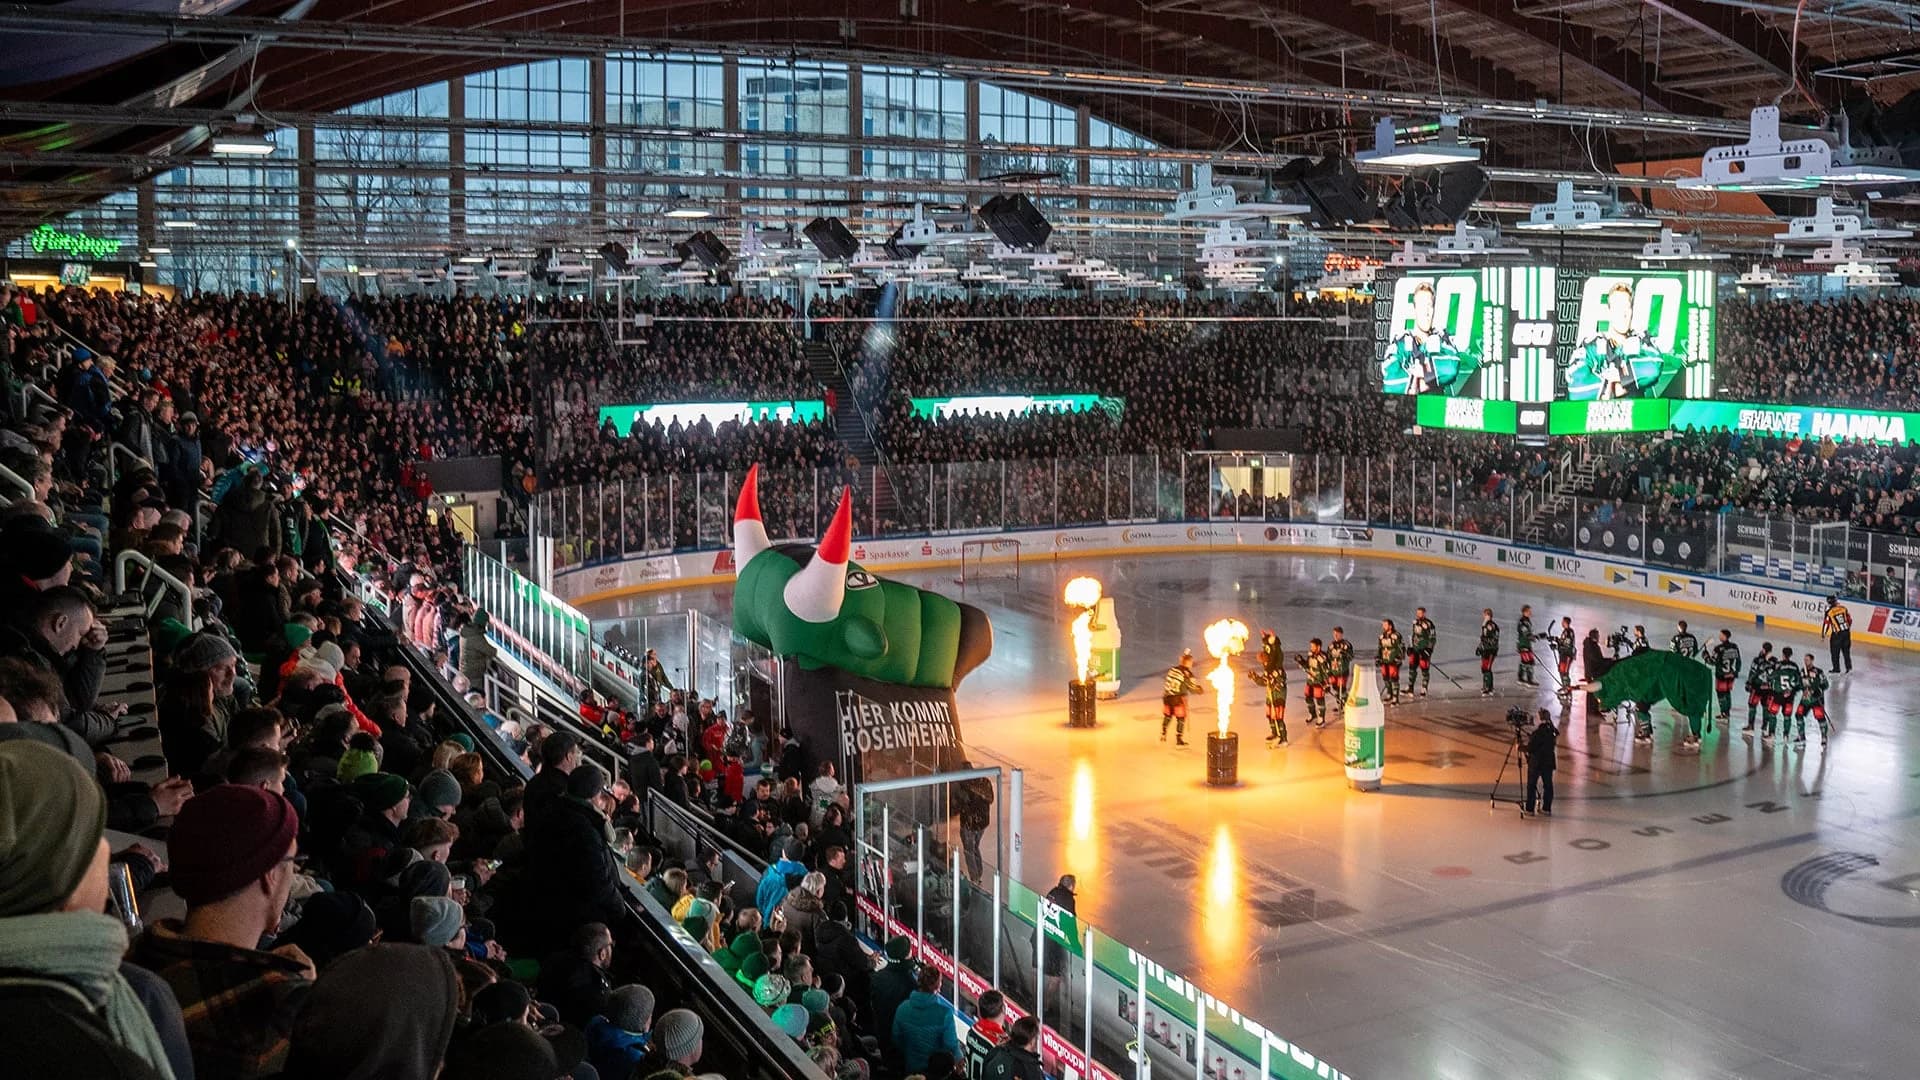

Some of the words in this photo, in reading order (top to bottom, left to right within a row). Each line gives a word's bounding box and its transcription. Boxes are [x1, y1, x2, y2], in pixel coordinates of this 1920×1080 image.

[1738, 409, 1801, 432] SHANE
[1811, 412, 1906, 443] HANNA
[1408, 535, 1432, 549] MCP
[1455, 541, 1478, 556] MCP
[1888, 543, 1920, 556] SCHWAD
[869, 549, 910, 560] Sparkasse
[1508, 551, 1532, 565] MCP
[1556, 559, 1581, 574] MCP
[1889, 610, 1920, 628] SÜ
[840, 703, 886, 731] HIER
[889, 701, 951, 724] KOMMT
